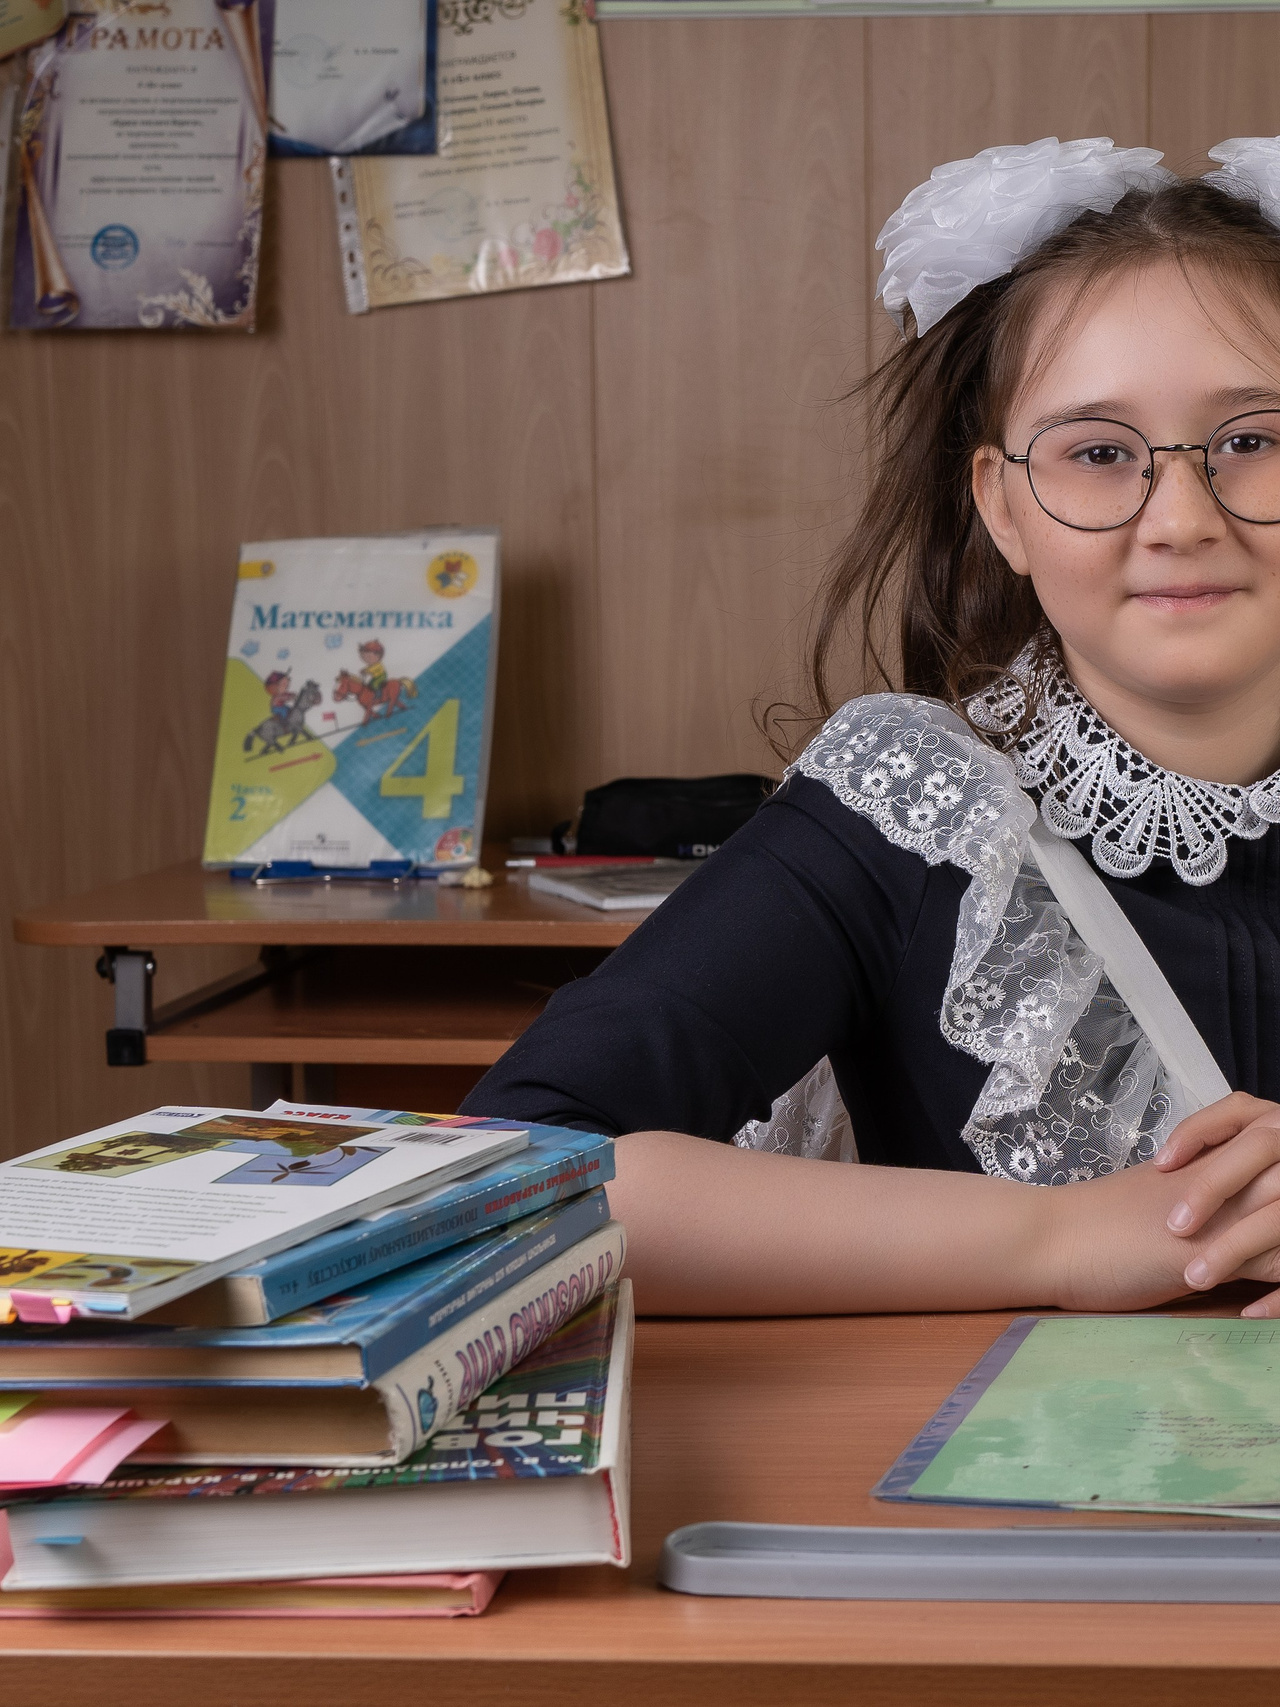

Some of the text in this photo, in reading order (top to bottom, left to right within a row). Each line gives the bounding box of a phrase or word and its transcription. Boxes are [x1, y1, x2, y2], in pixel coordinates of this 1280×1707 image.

[66, 14, 226, 52] ГРАМОТА
[249, 602, 455, 632] Математика
[379, 698, 466, 820] 4
[229, 797, 248, 822] 2
[484, 1180, 545, 1215] РАЗРАБОТКИ
[367, 1211, 464, 1261] ИЗОБРАЗИТЕЛЬНОМУ
[305, 1247, 368, 1288] ИСКУССТВУ
[510, 1264, 595, 1367] ПОЗНАЮ
[455, 1325, 507, 1410] МИР
